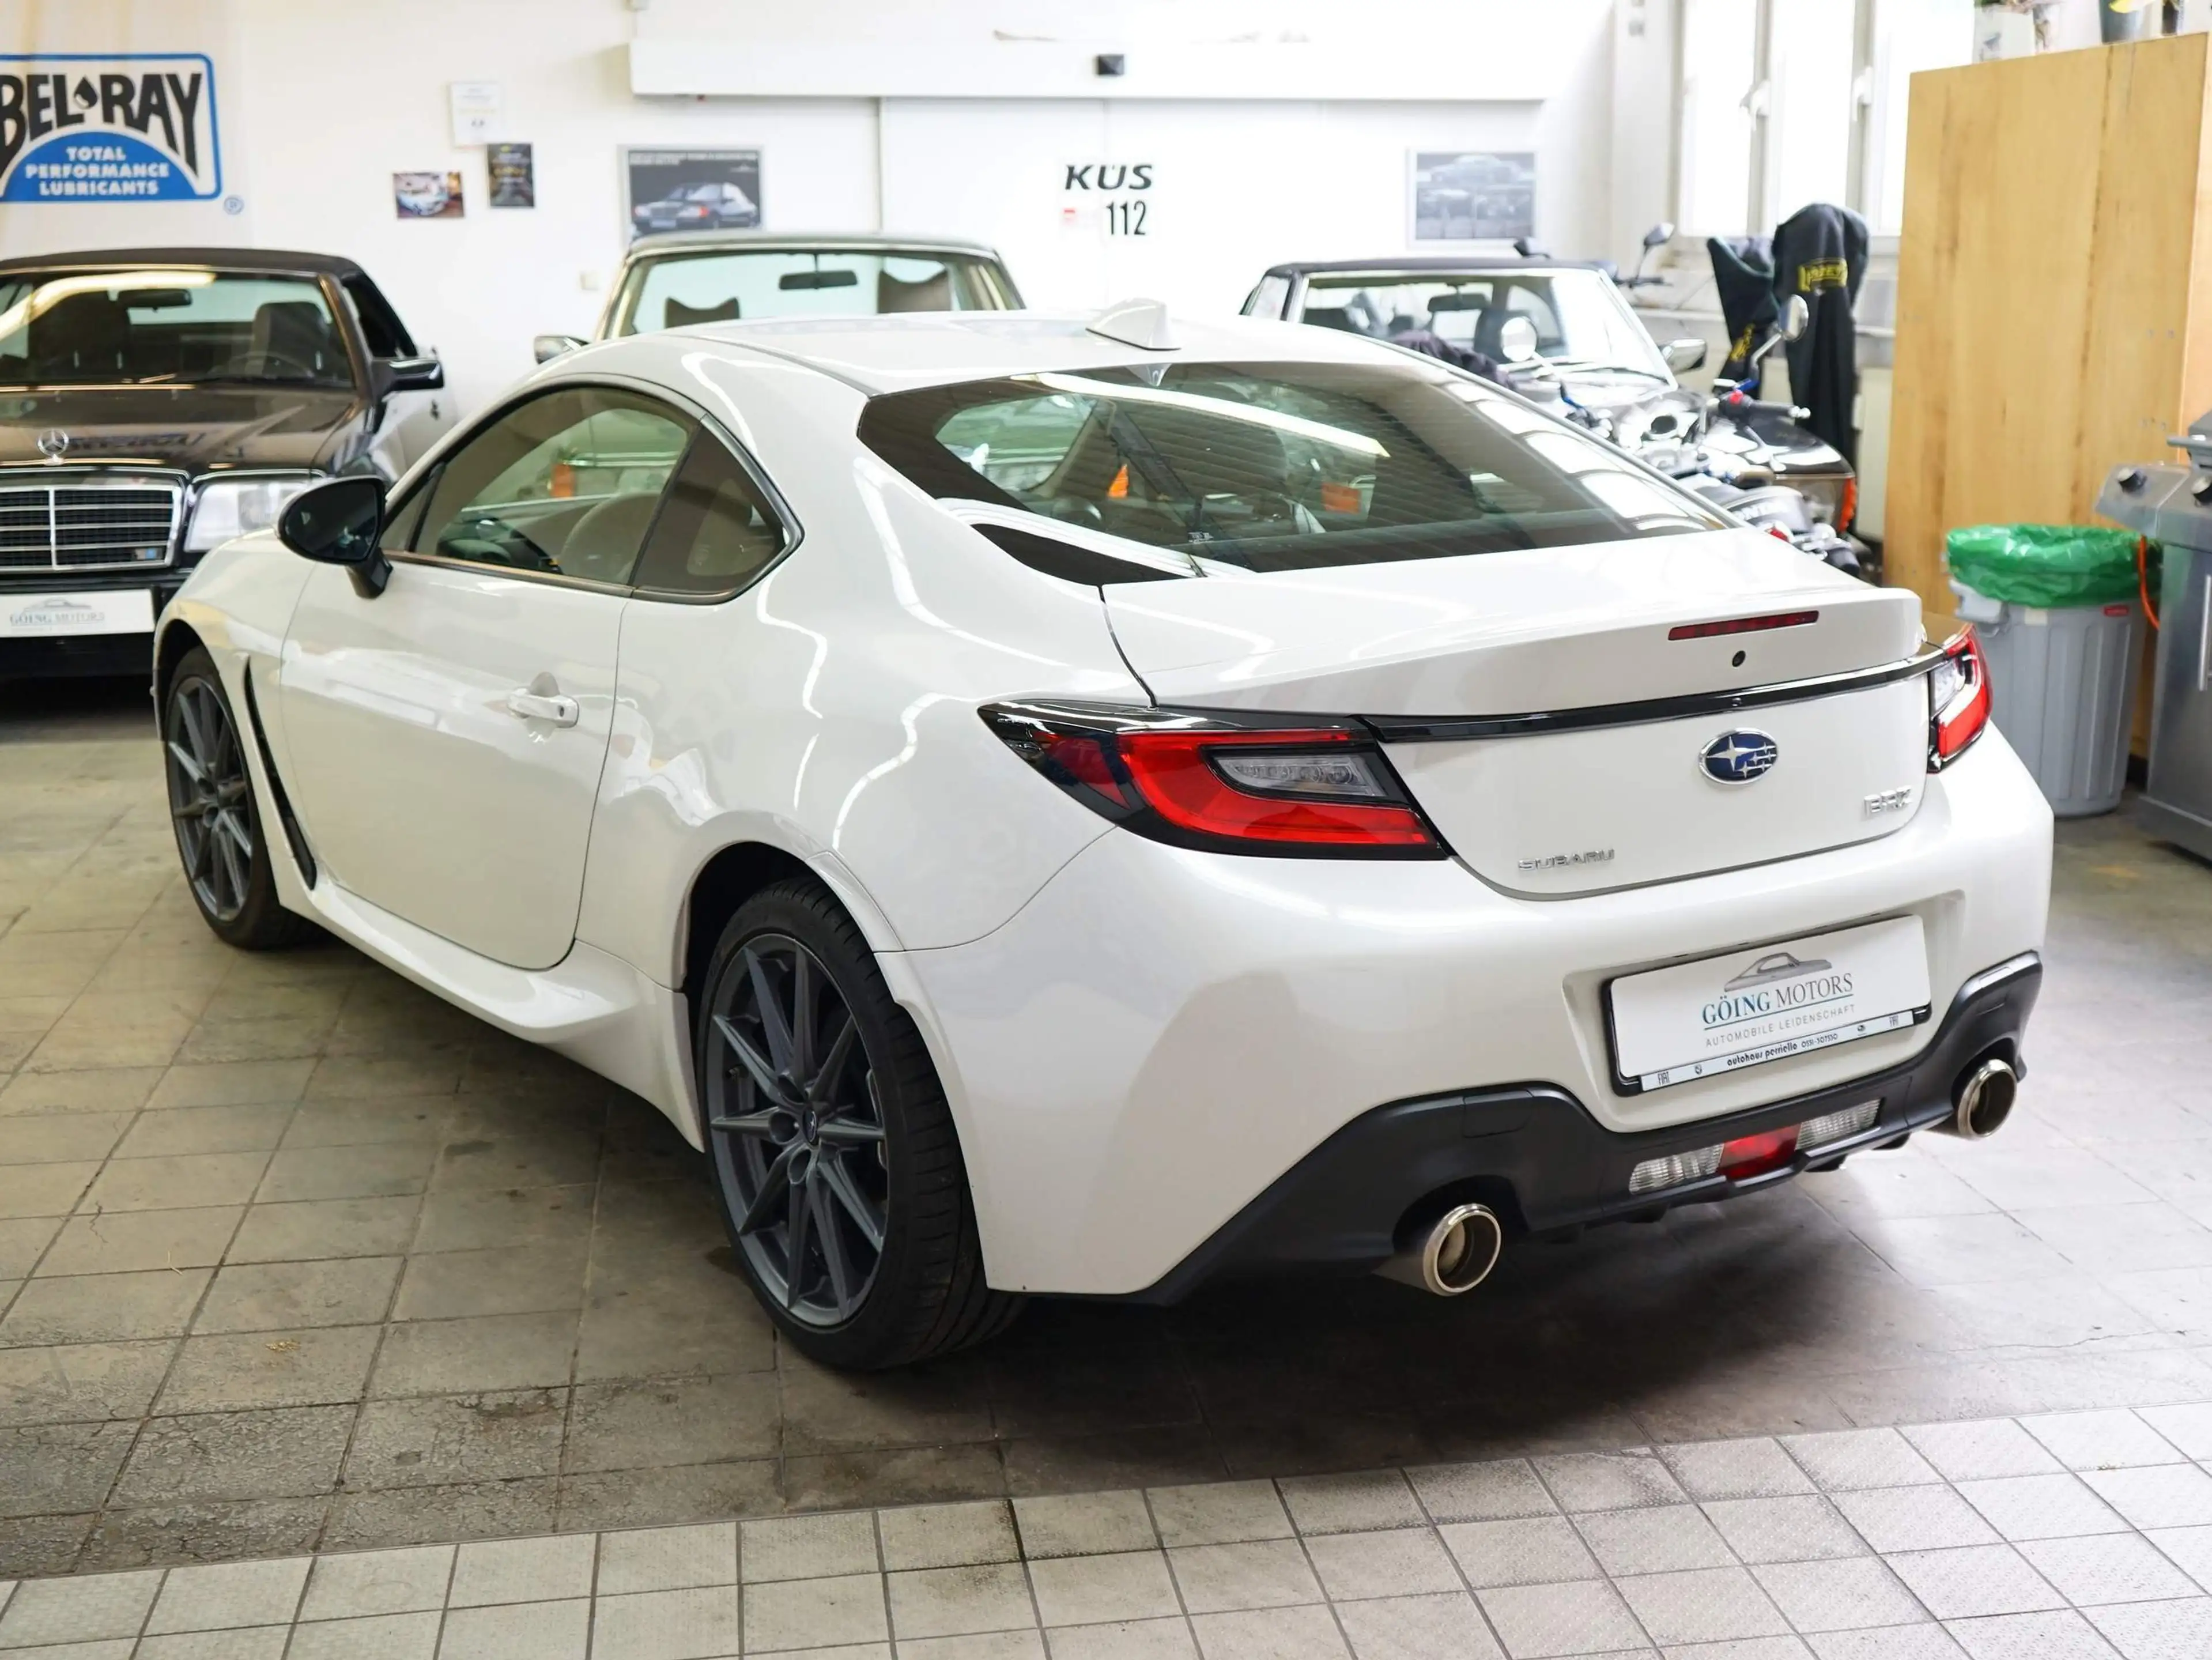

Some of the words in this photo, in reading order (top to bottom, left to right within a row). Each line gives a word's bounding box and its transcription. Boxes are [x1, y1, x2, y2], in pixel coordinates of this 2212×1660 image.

[65, 146, 126, 161] TOTAL
[25, 163, 169, 179] PERFORMANCE
[1065, 164, 1152, 190] KÜS
[39, 180, 159, 195] LUBRICANTS
[1106, 200, 1146, 235] 112
[1863, 784, 1912, 817] BRZ
[1518, 848, 1615, 871] SUBARU
[1702, 991, 1771, 1025] GÖING
[1776, 973, 1853, 1008] MOTORS
[1705, 1023, 1774, 1047] AUTOMOBILE
[1779, 1004, 1855, 1030] LEIDENSCHAFT
[1727, 1052, 1763, 1066] autohaus
[1765, 1042, 1798, 1059] perriello
